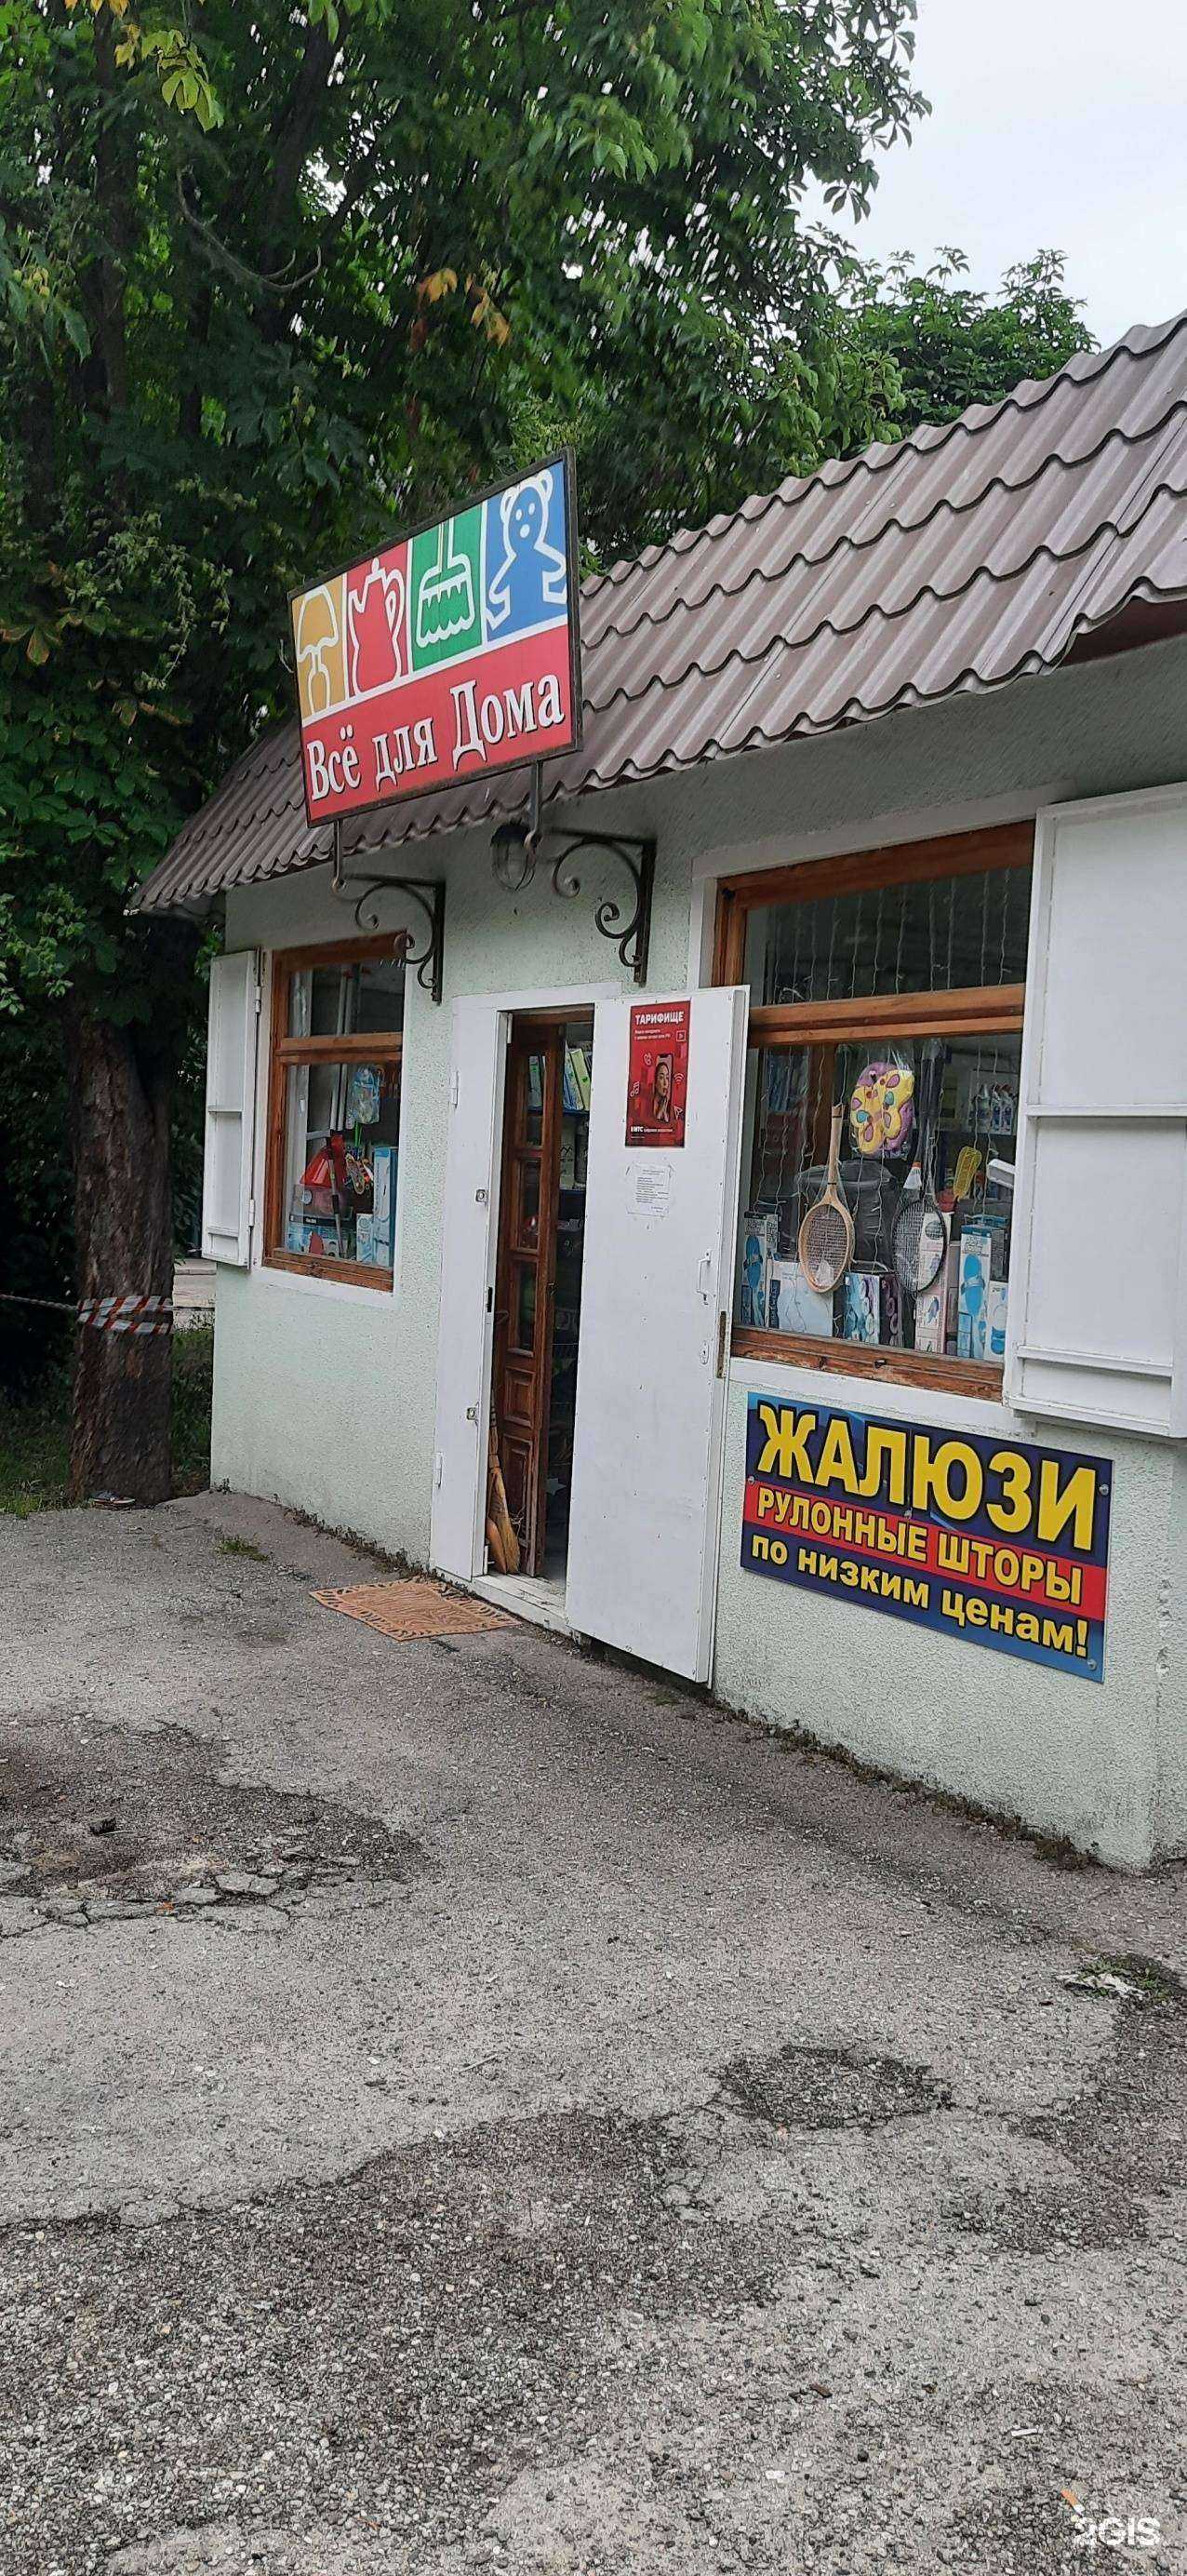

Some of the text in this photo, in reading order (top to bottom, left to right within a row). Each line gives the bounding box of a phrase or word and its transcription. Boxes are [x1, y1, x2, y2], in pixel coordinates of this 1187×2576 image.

[306, 674, 566, 802] Всё для Дома
[634, 1011, 686, 1026] ТАРИФИЩЕ
[756, 1402, 1098, 1552] ЖАЛЮЗИ
[751, 1533, 1089, 1658] по низким ценам!
[756, 1487, 1084, 1606] РУЛОННЫЕ ШТОРЫ
